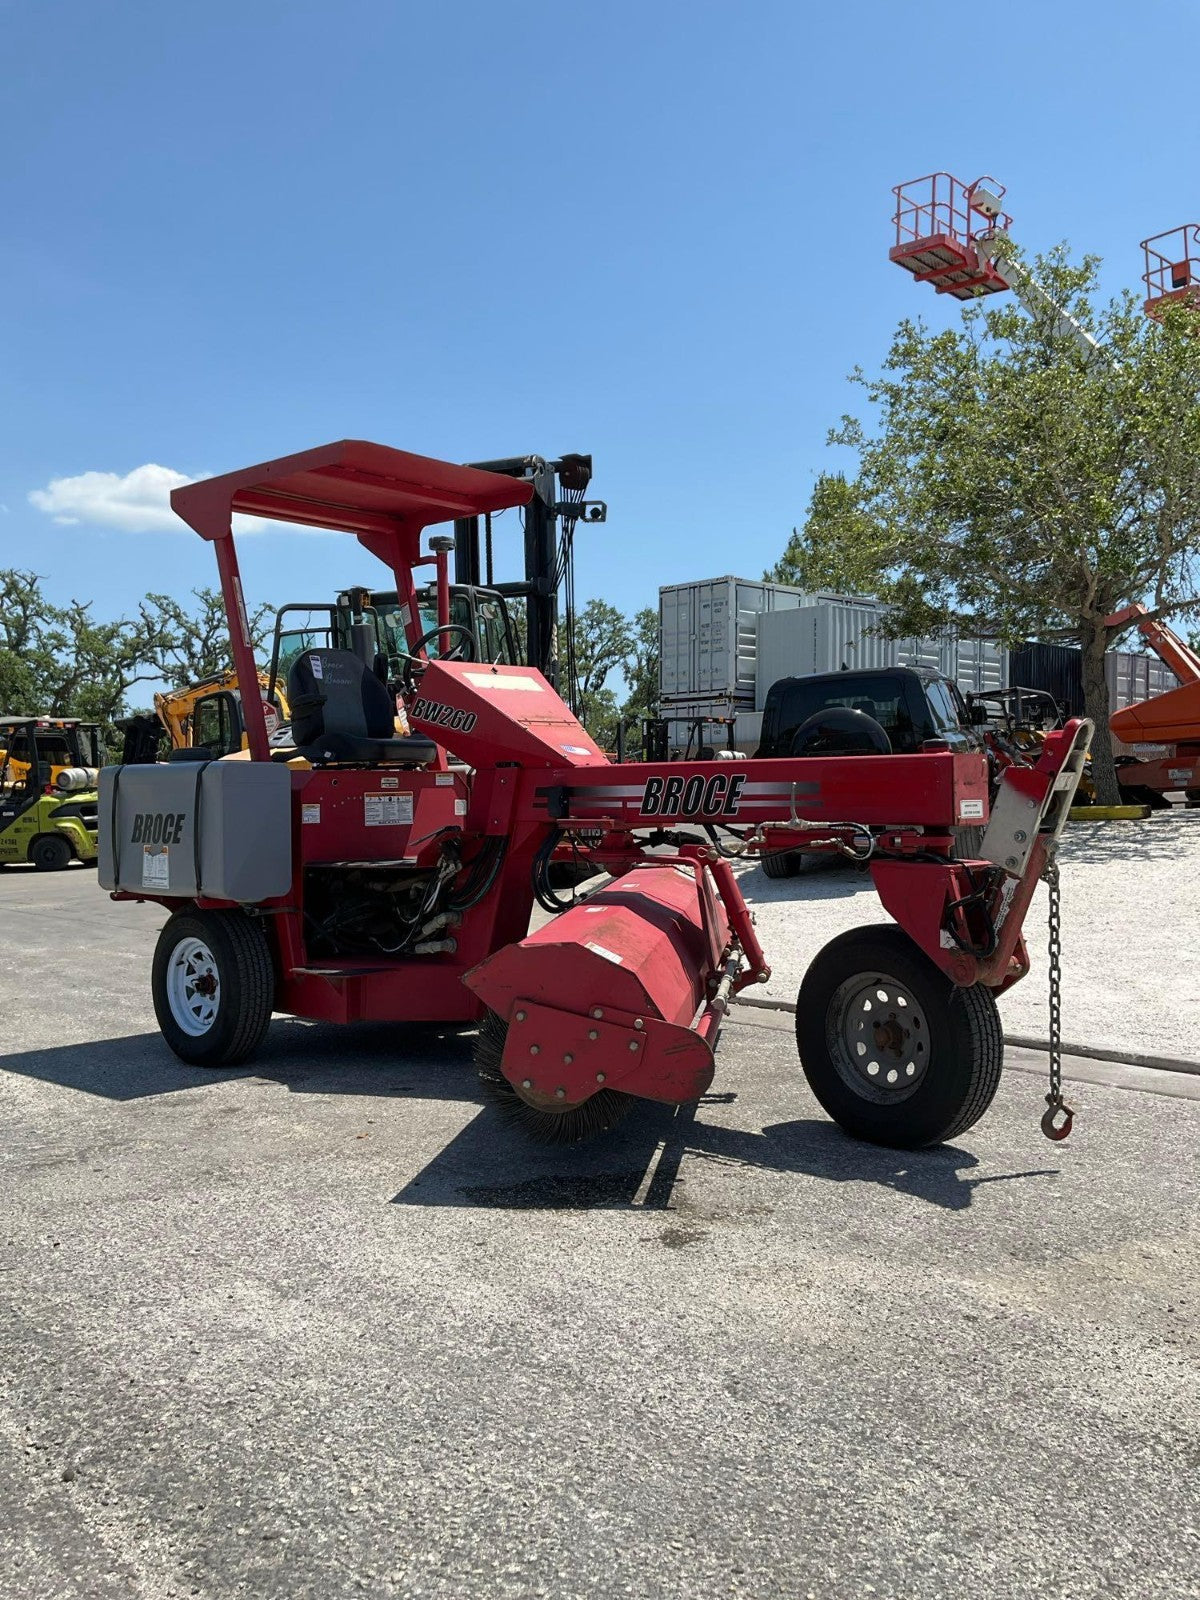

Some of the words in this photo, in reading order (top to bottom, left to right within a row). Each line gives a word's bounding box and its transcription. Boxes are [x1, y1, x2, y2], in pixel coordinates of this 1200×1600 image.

[411, 698, 477, 734] BW260
[639, 774, 747, 816] BROCE
[131, 813, 186, 844] BROCE
